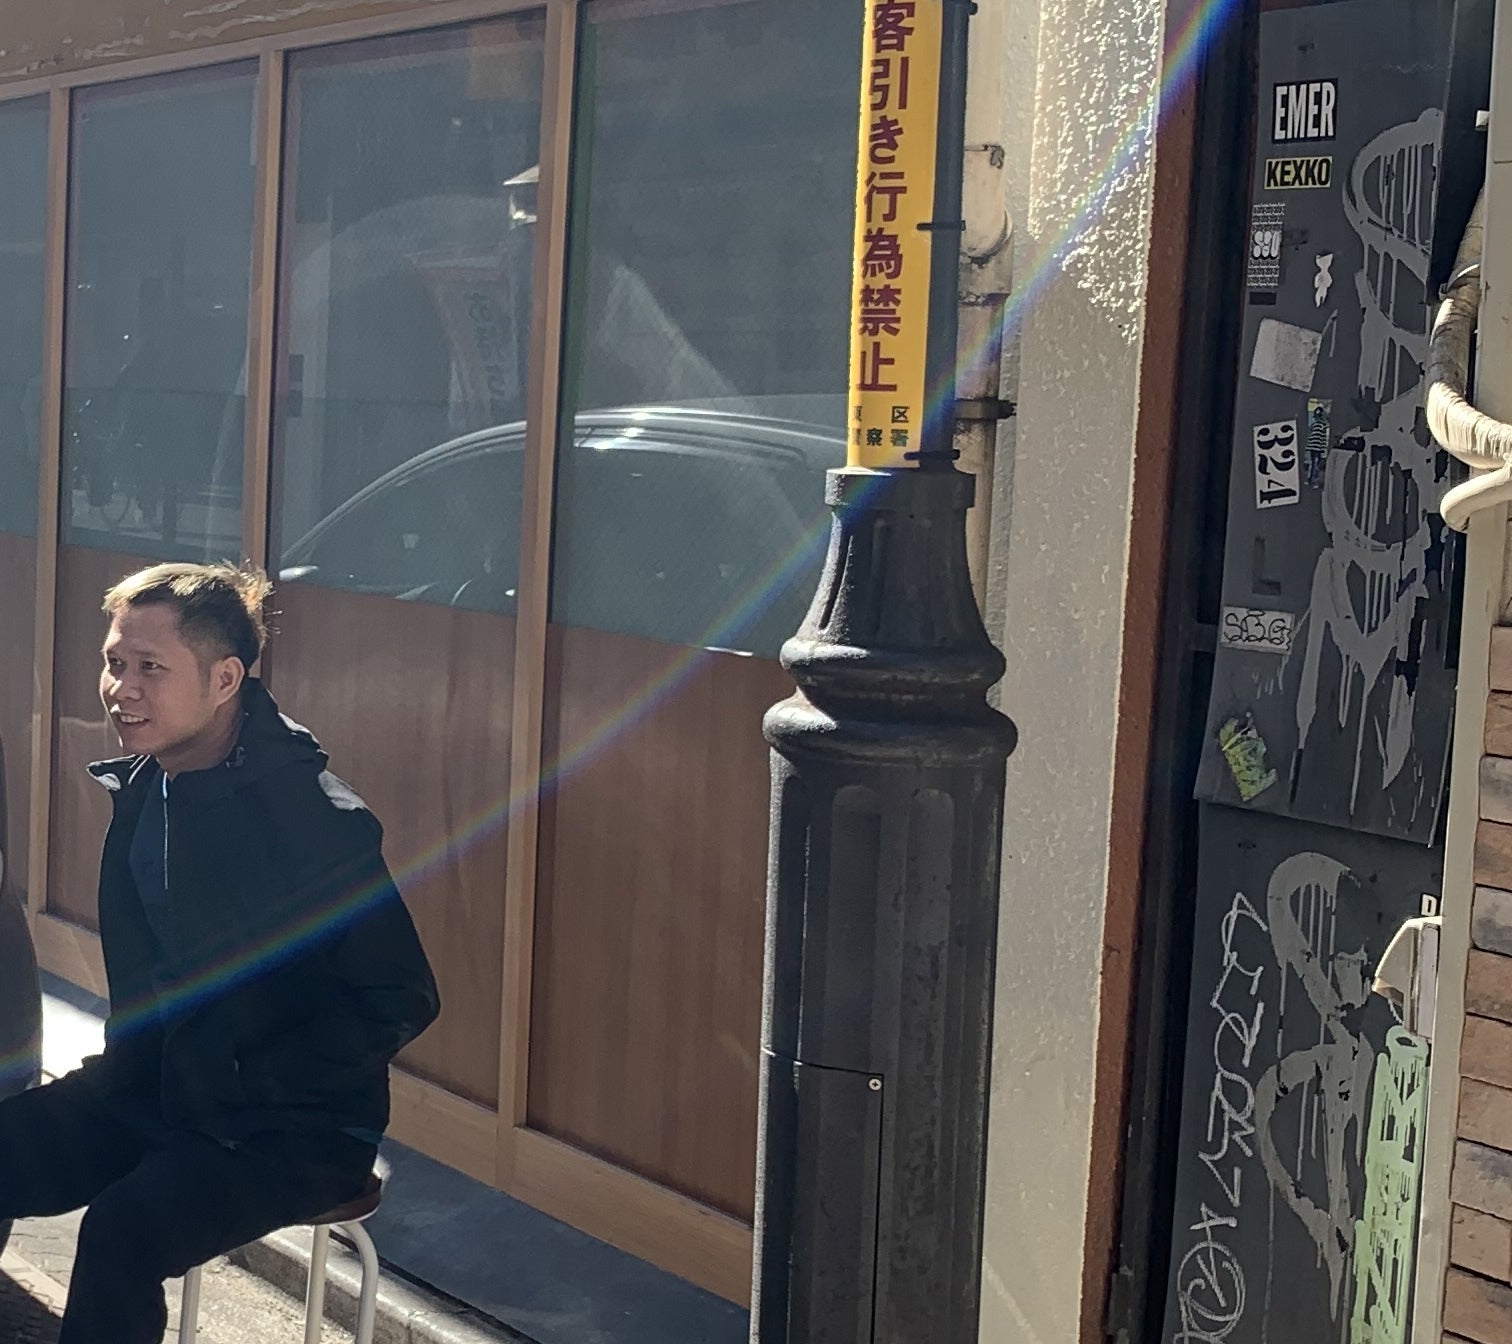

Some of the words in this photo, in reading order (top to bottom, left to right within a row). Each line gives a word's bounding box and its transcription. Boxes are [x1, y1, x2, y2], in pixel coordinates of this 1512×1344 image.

[1274, 80, 1336, 141] EMER
[1265, 157, 1332, 188] KEXKO
[1257, 424, 1297, 505] 324
